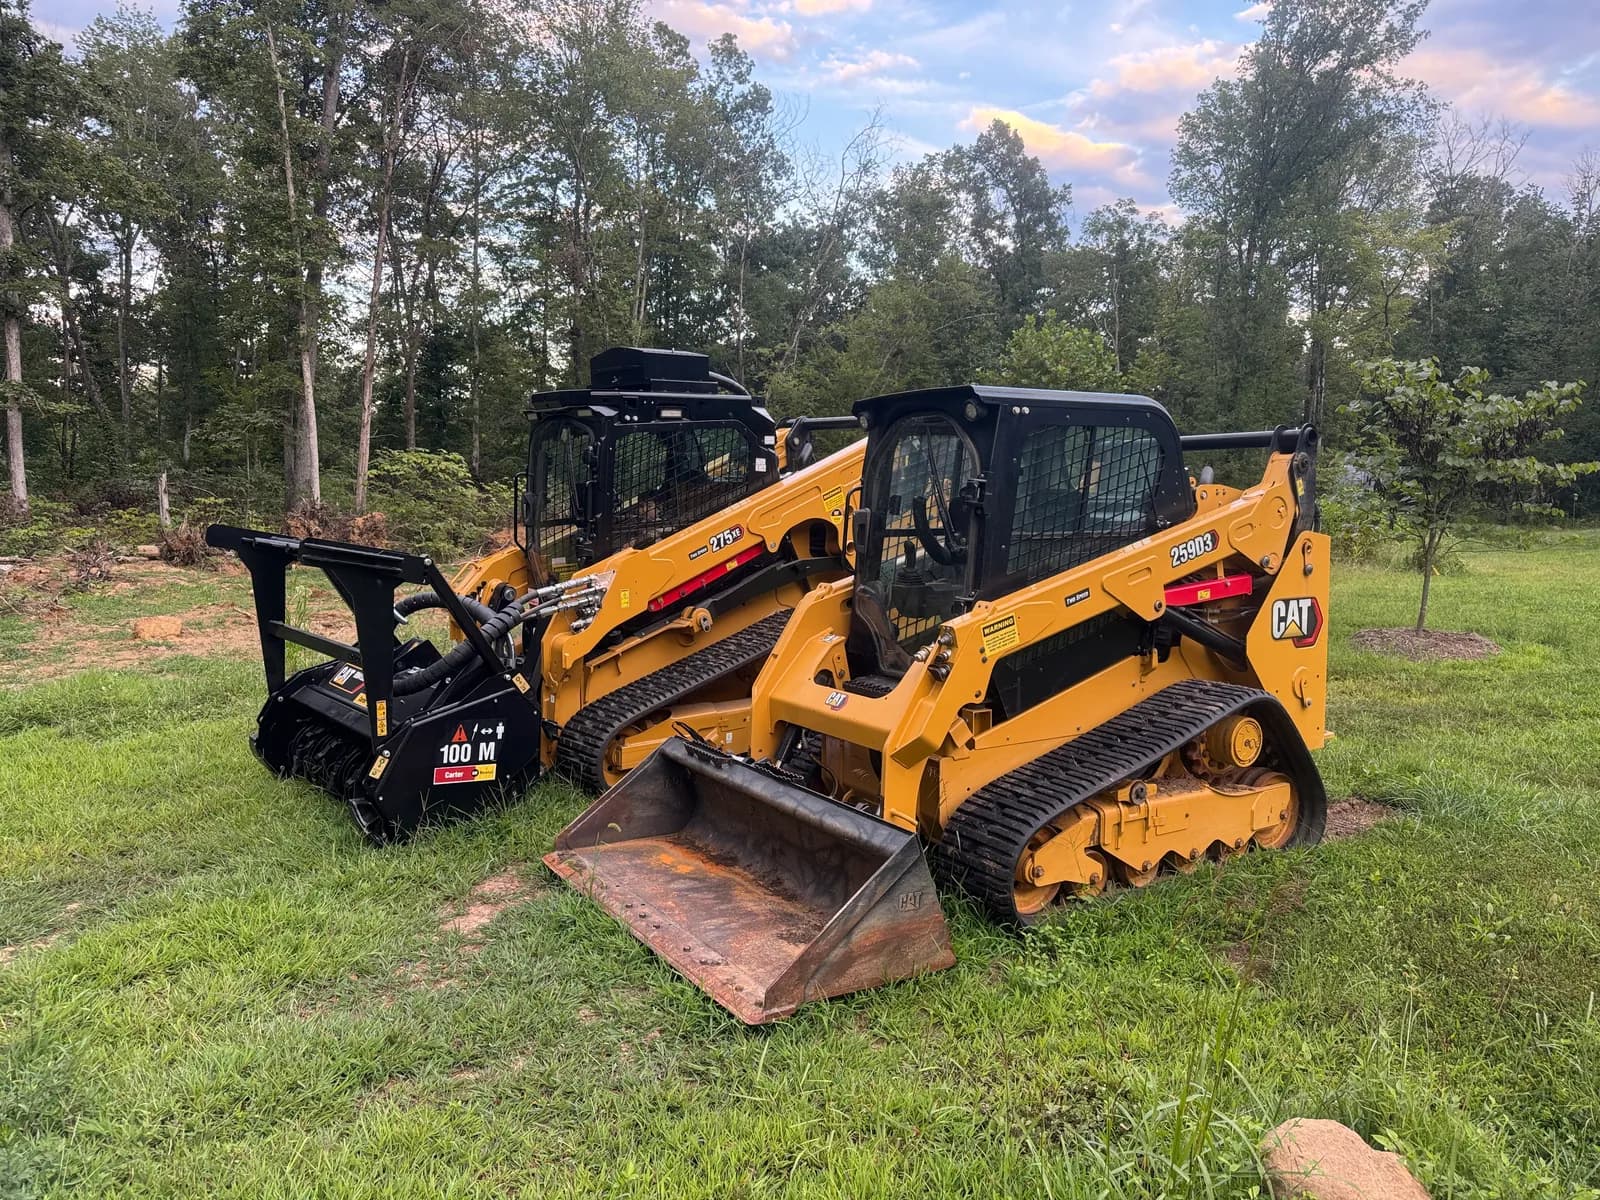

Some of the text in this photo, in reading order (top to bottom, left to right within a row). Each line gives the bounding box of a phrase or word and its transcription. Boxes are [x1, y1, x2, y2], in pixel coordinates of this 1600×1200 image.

[710, 527, 741, 552] 275XE
[1171, 532, 1213, 568] 259D3
[983, 617, 1014, 635] WARNING
[1272, 598, 1312, 639] CAT
[825, 691, 847, 707] CAT
[440, 741, 496, 764] 100 M
[444, 771, 464, 779] Carter
